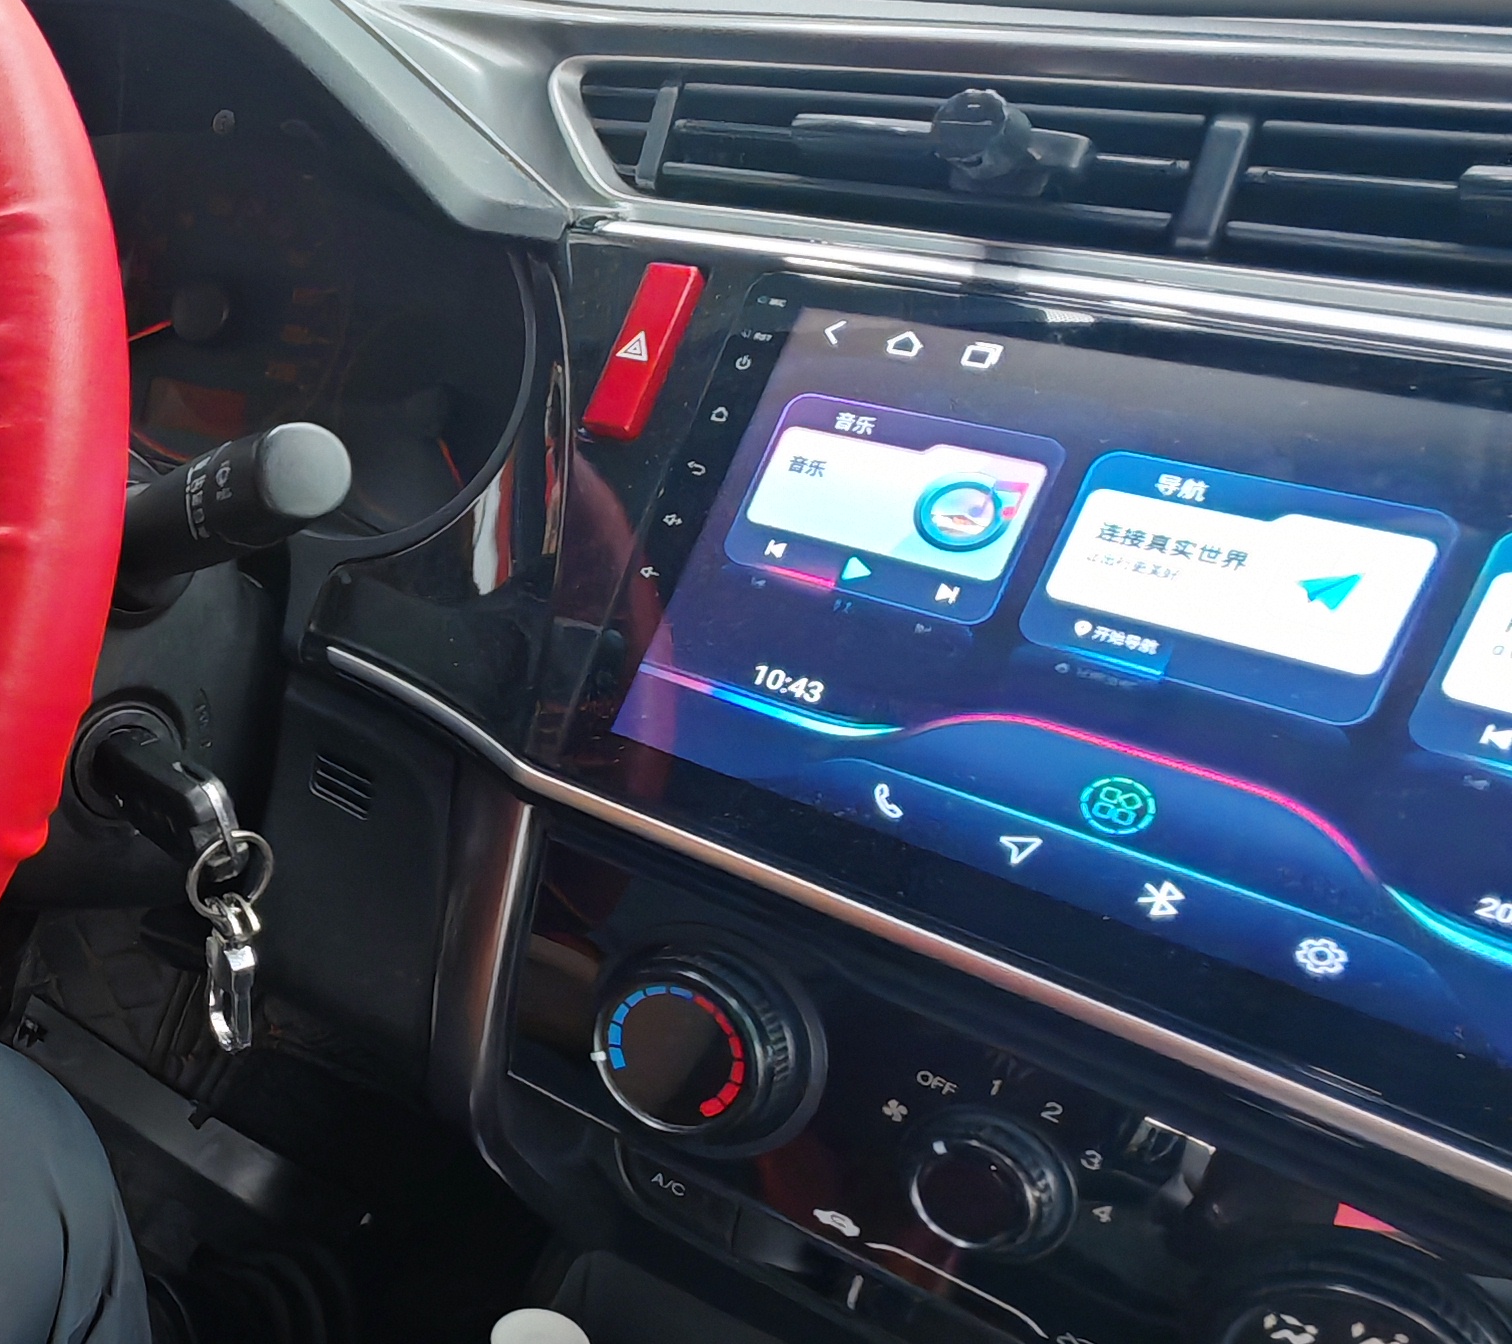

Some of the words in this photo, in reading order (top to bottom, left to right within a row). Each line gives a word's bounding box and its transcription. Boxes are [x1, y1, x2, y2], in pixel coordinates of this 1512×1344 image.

[834, 412, 878, 436] 音乐
[788, 455, 828, 478] 音乐
[1154, 473, 1210, 502] 导航
[1095, 521, 1249, 572] 连接真实世界
[753, 664, 825, 703] 10:43
[916, 1070, 959, 1096] OFF
[990, 1079, 1003, 1096] 1
[1040, 1101, 1064, 1124] 2
[1080, 1149, 1104, 1171] 3
[651, 1172, 686, 1197] A/C
[1092, 1205, 1114, 1224] 4
